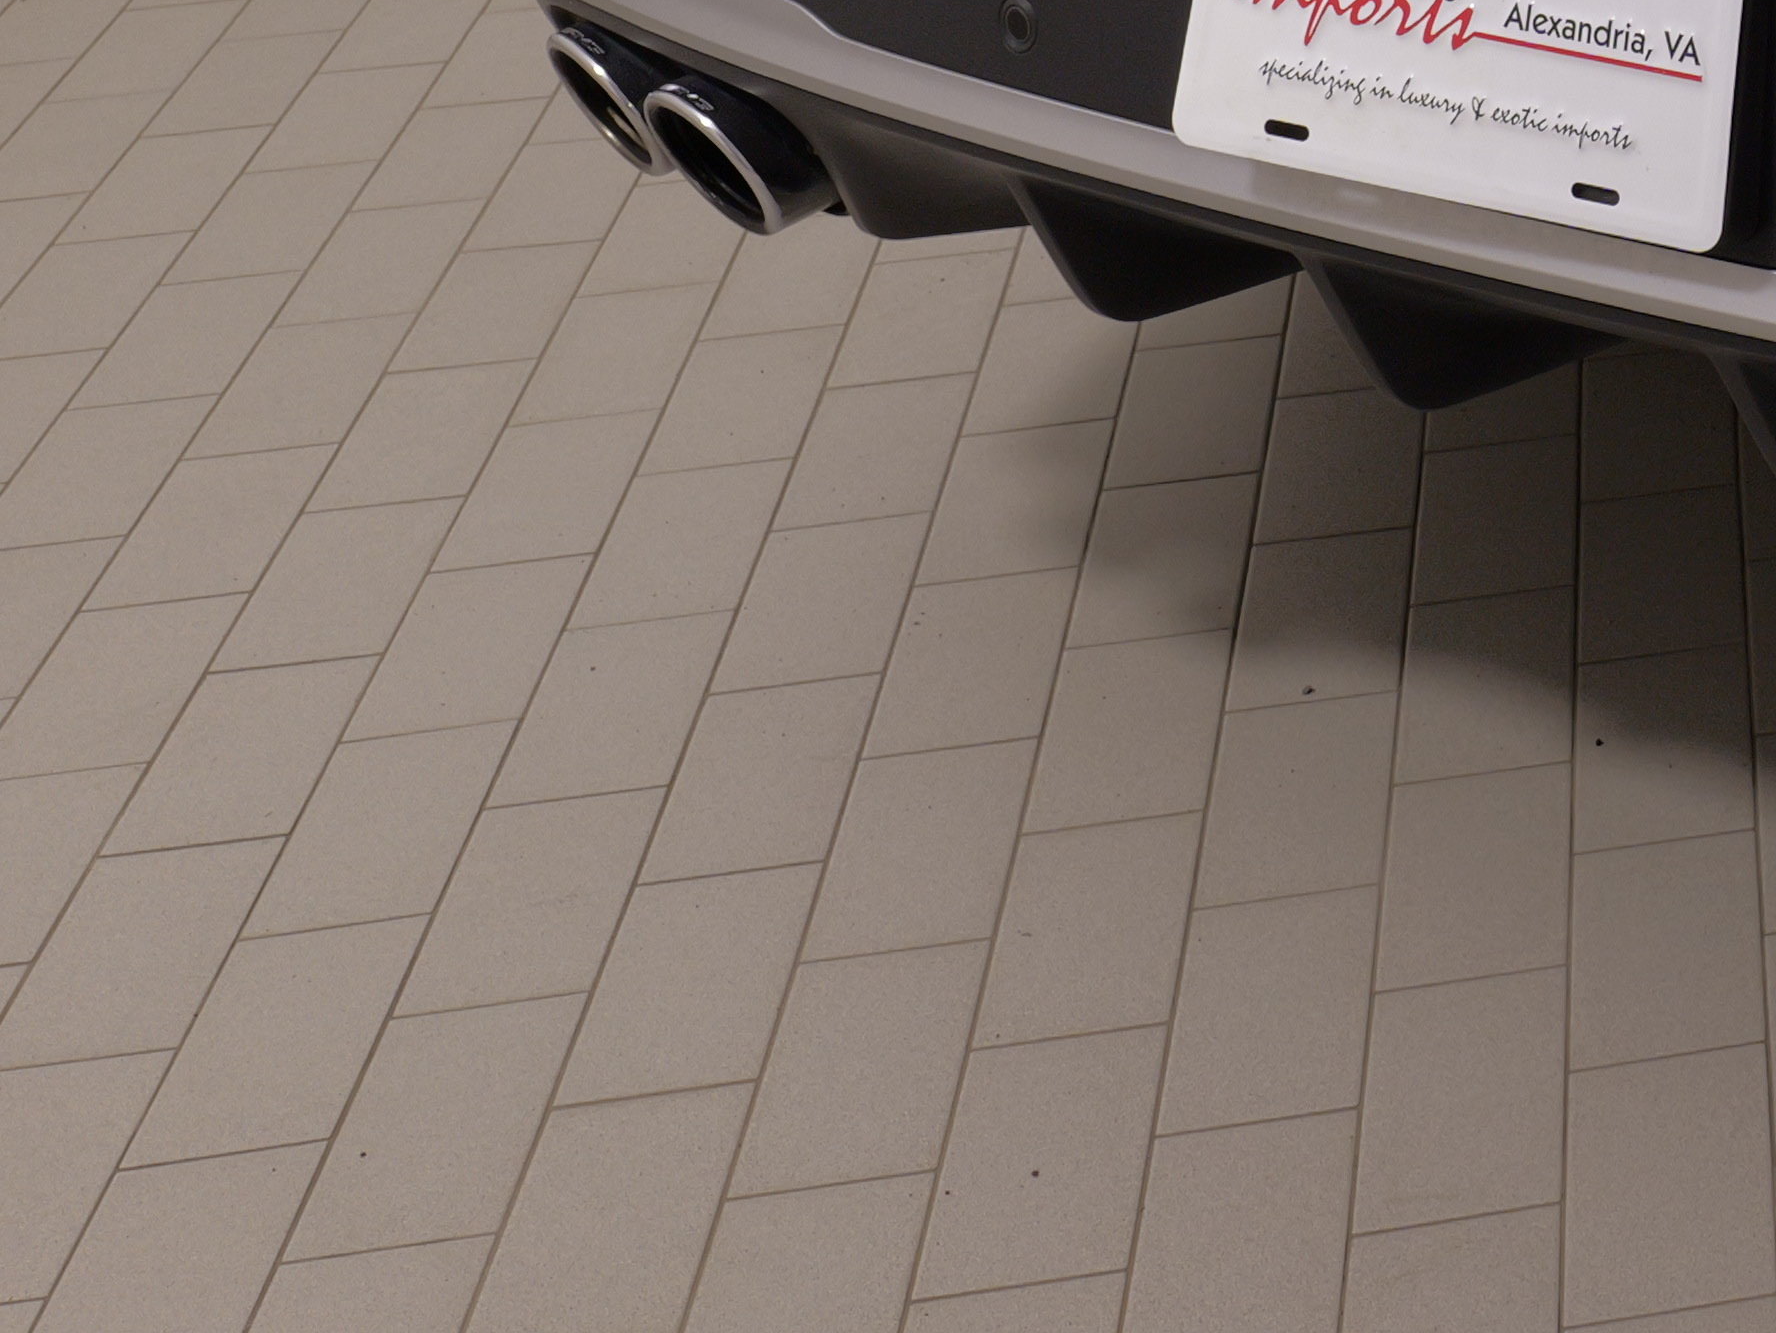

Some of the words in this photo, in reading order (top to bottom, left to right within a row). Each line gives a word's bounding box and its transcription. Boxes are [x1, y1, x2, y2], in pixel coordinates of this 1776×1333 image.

[1503, 2, 1653, 62] Alexandria,
[1664, 31, 1701, 67] VA
[1259, 58, 1366, 106] specializing
[1369, 76, 1394, 100] in
[1398, 77, 1465, 125] luxury
[1471, 96, 1486, 121] &
[1490, 107, 1549, 132] exotic
[1550, 113, 1632, 150] imports
